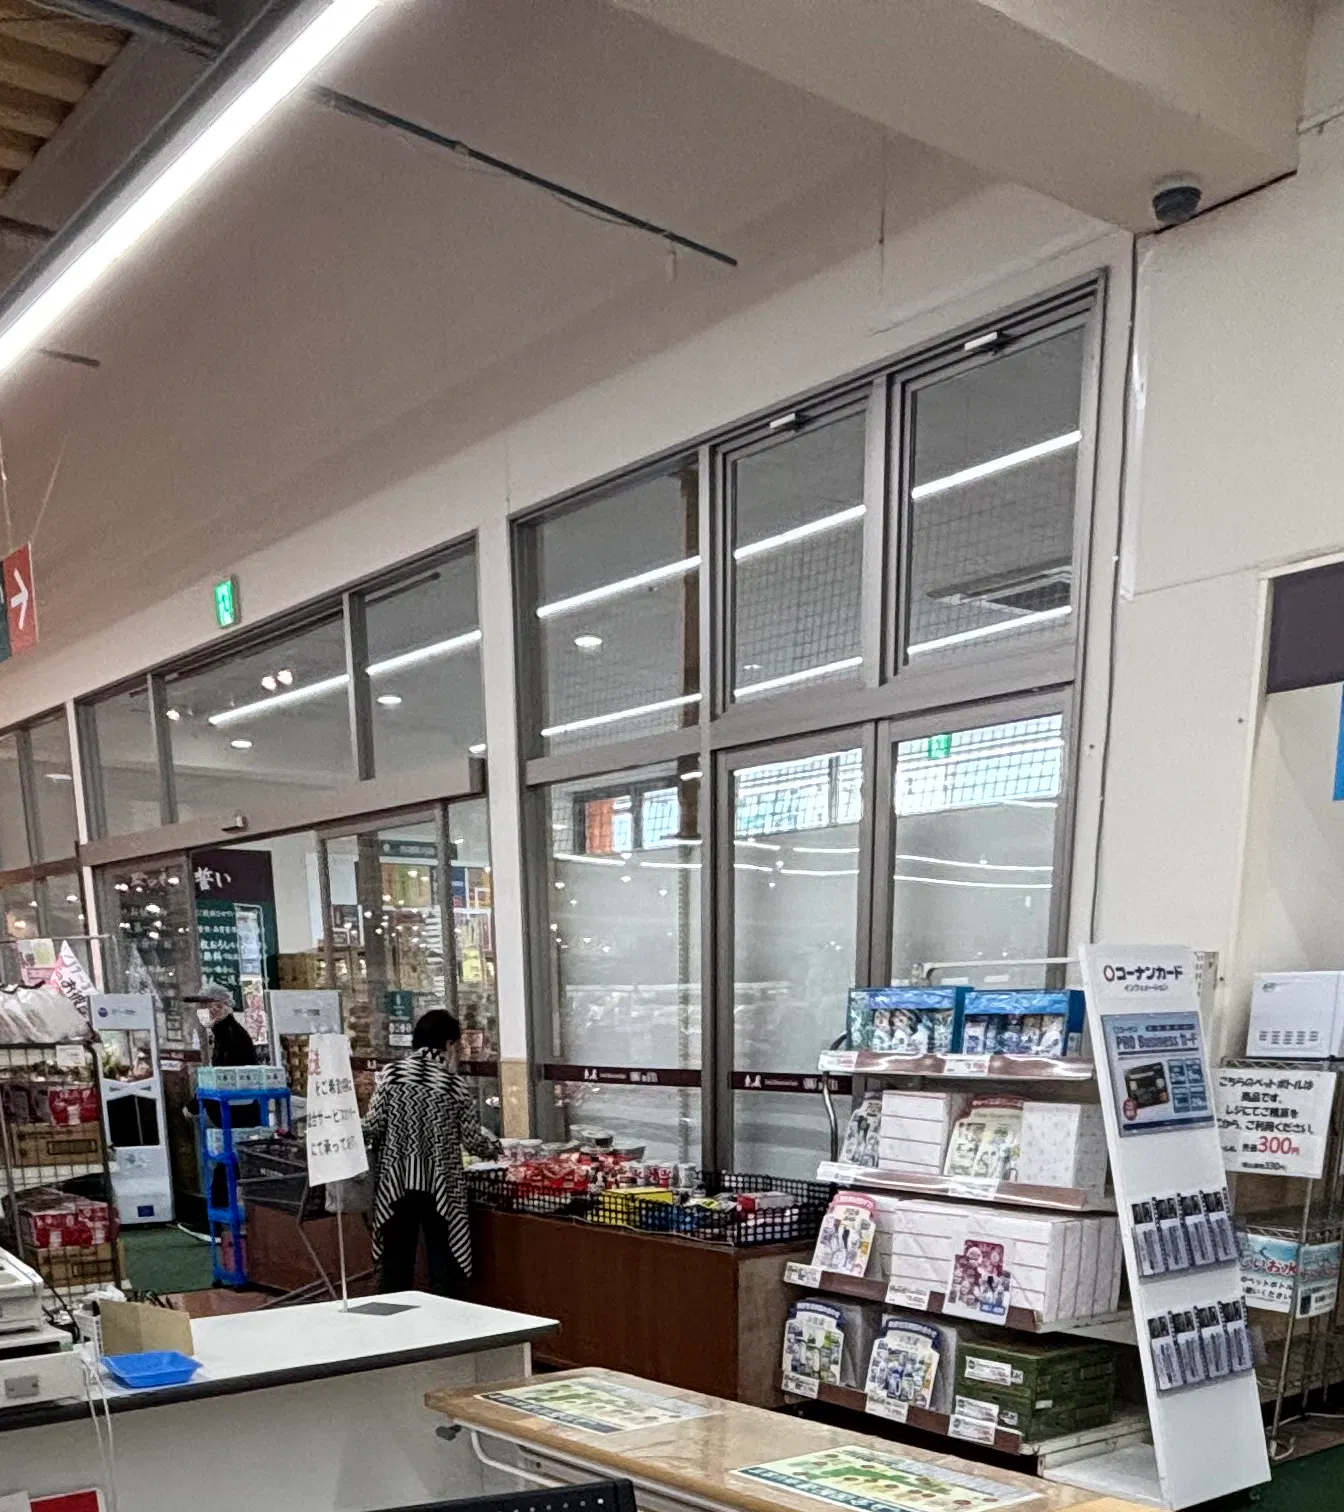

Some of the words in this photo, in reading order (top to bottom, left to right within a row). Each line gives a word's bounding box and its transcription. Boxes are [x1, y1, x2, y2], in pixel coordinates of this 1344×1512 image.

[1114, 963, 1185, 982] コーナンカード
